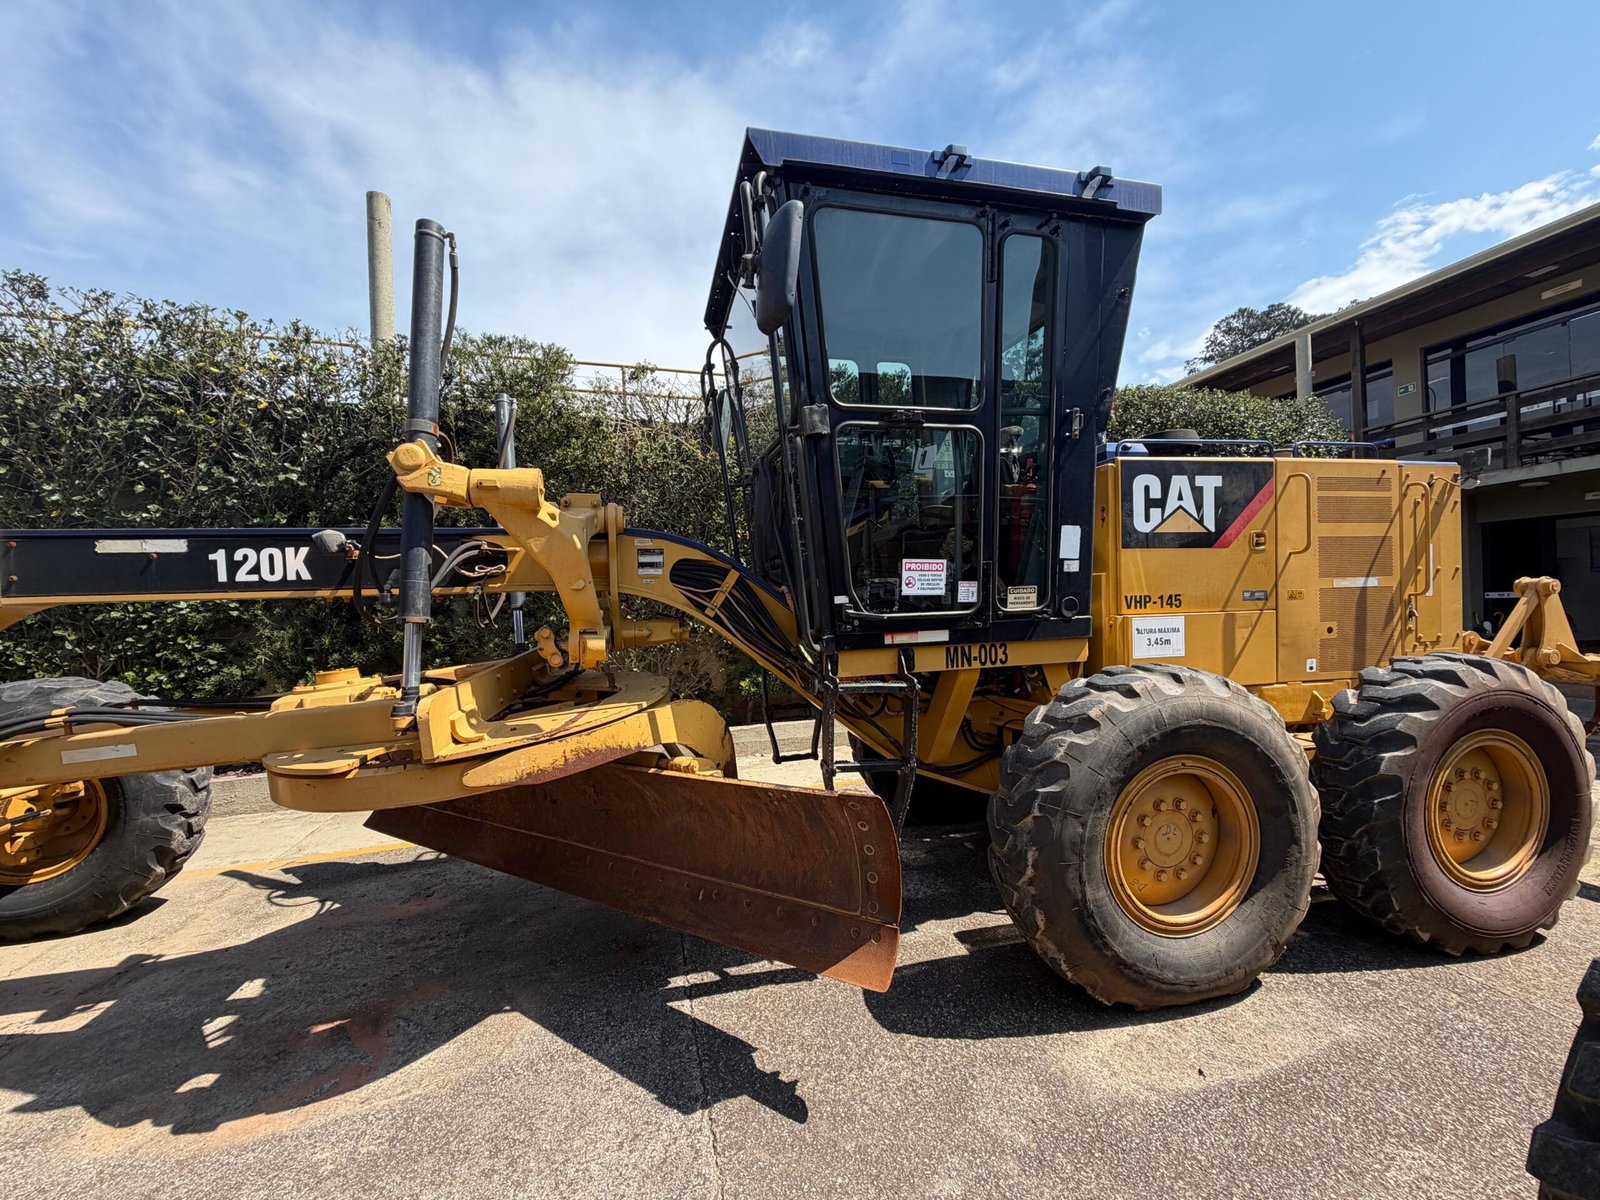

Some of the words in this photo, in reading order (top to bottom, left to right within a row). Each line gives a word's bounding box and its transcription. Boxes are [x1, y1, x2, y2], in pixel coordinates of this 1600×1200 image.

[1132, 473, 1223, 533] CAT
[207, 546, 313, 583] 120K
[905, 563, 943, 571] PROIBIDO
[1124, 594, 1182, 609] VHP-145
[1158, 626, 1181, 634] MÁXIMA
[1146, 637, 1171, 647] 3,45m
[945, 642, 1009, 669] MN-003
